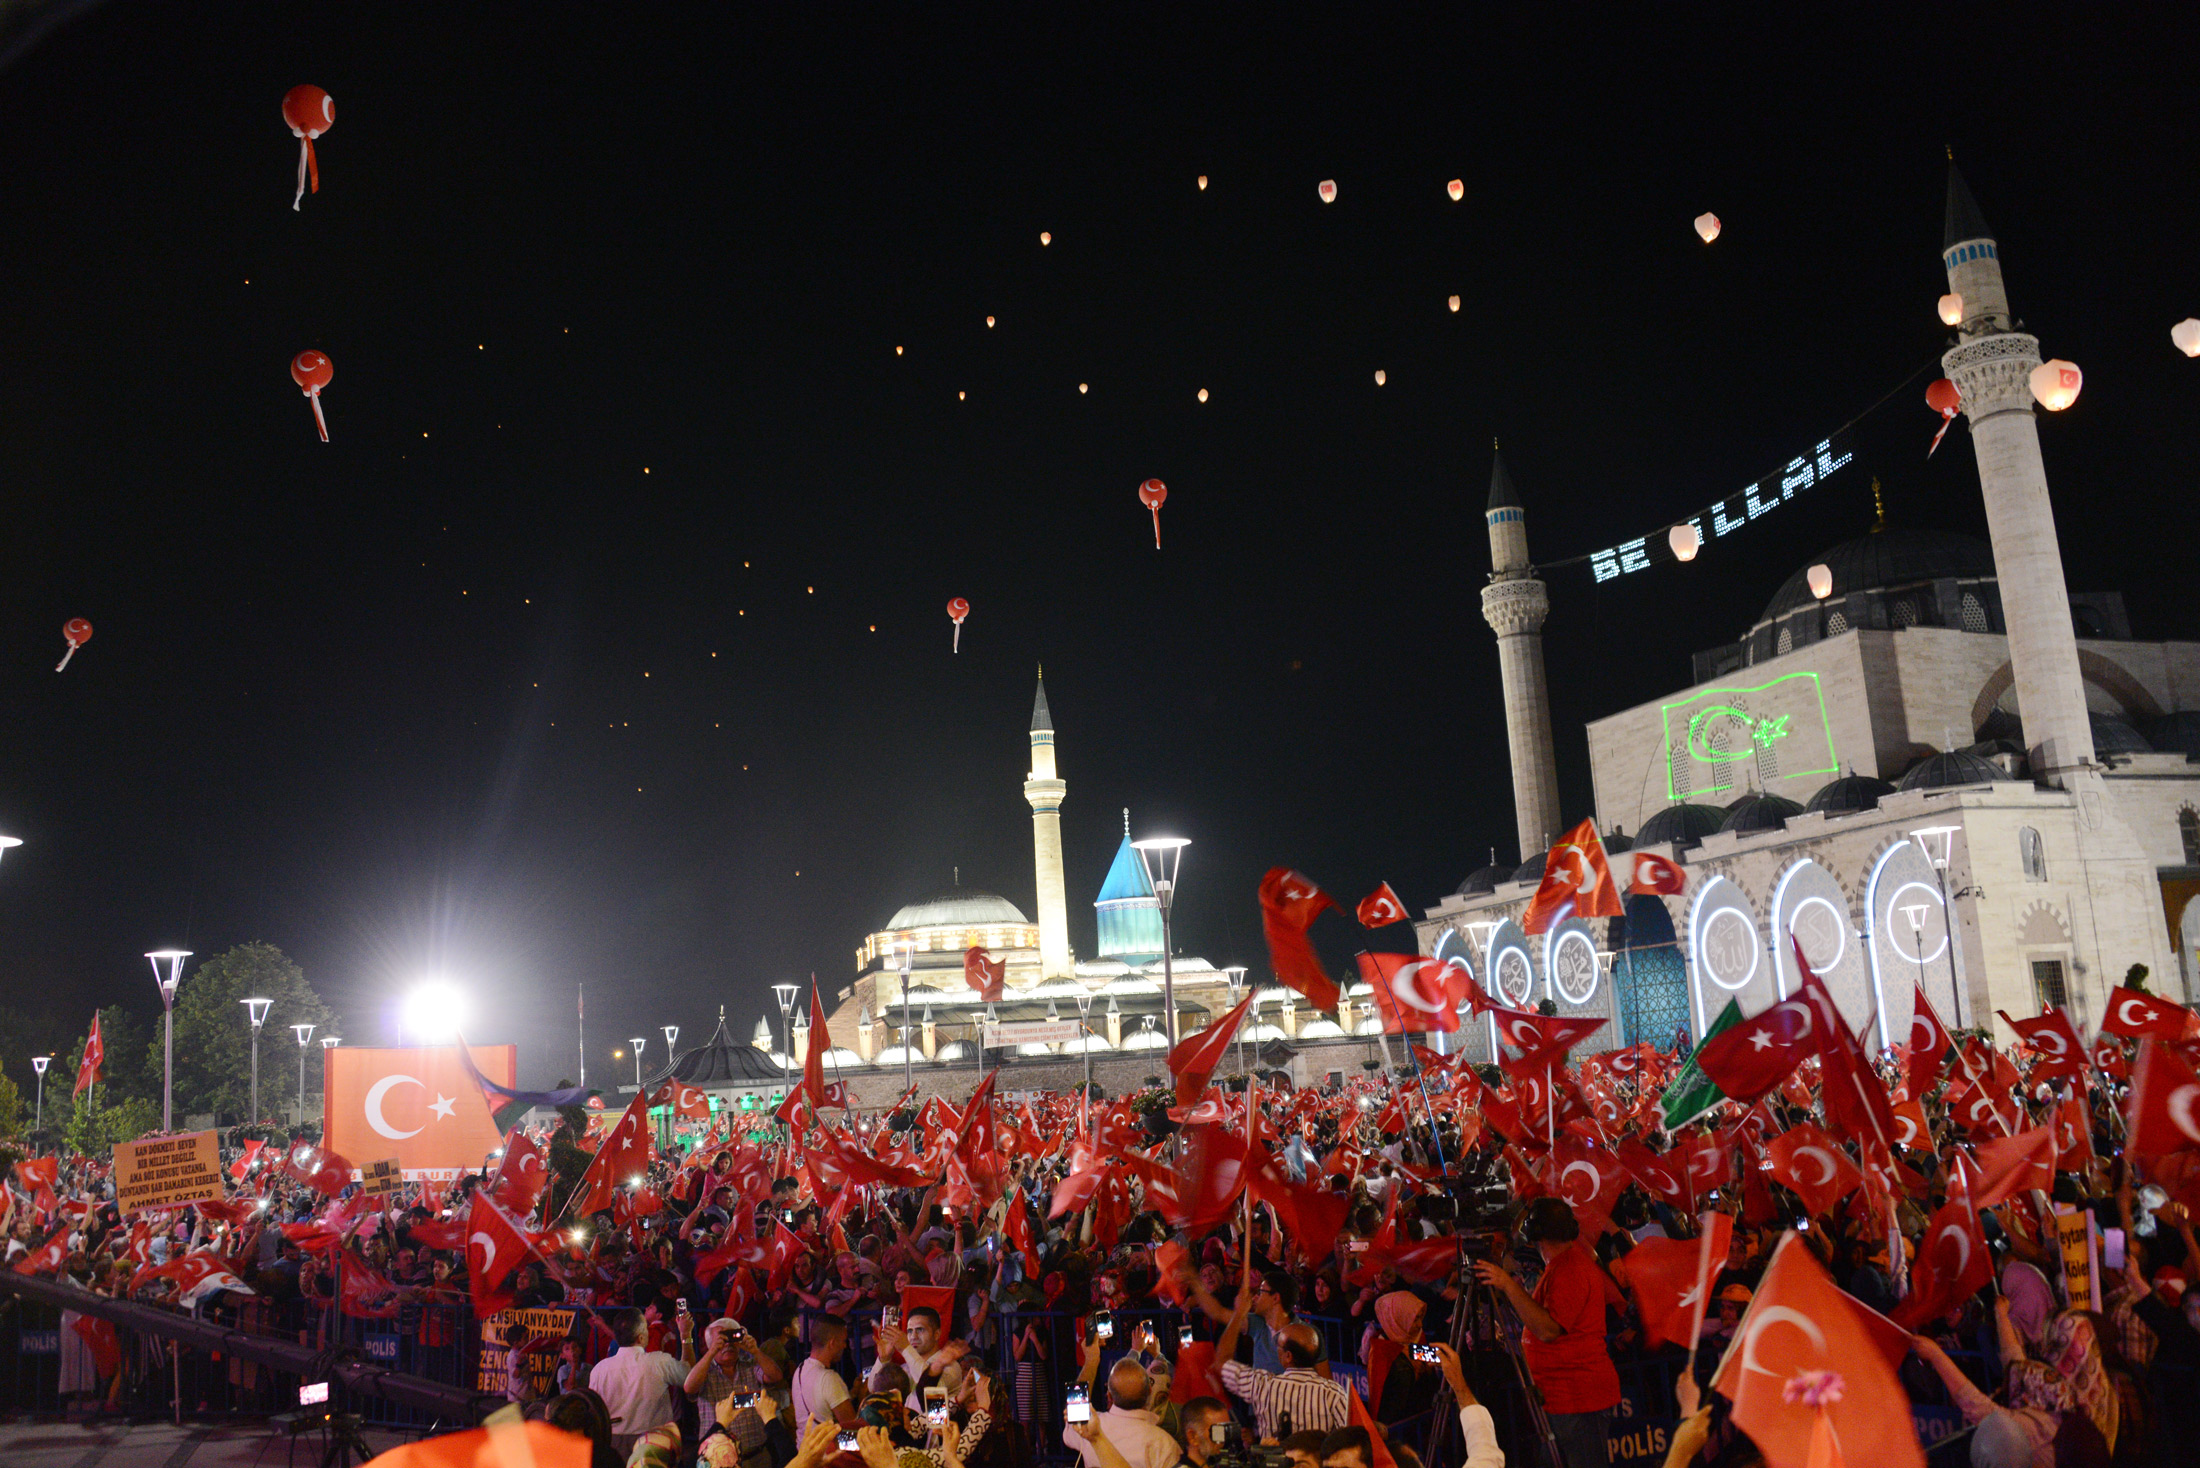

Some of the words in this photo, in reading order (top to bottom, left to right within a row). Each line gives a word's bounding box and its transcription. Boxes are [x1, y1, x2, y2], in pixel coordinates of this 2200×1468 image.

[1590, 537, 1651, 583] BE
[177, 1138, 197, 1151] SEVEN
[128, 1196, 171, 1209] AHMET
[174, 1189, 213, 1202] ÖZTAŞ
[365, 1338, 396, 1357] POLİS
[1332, 1369, 1369, 1396] POİS
[1607, 1424, 1667, 1464] POLİS
